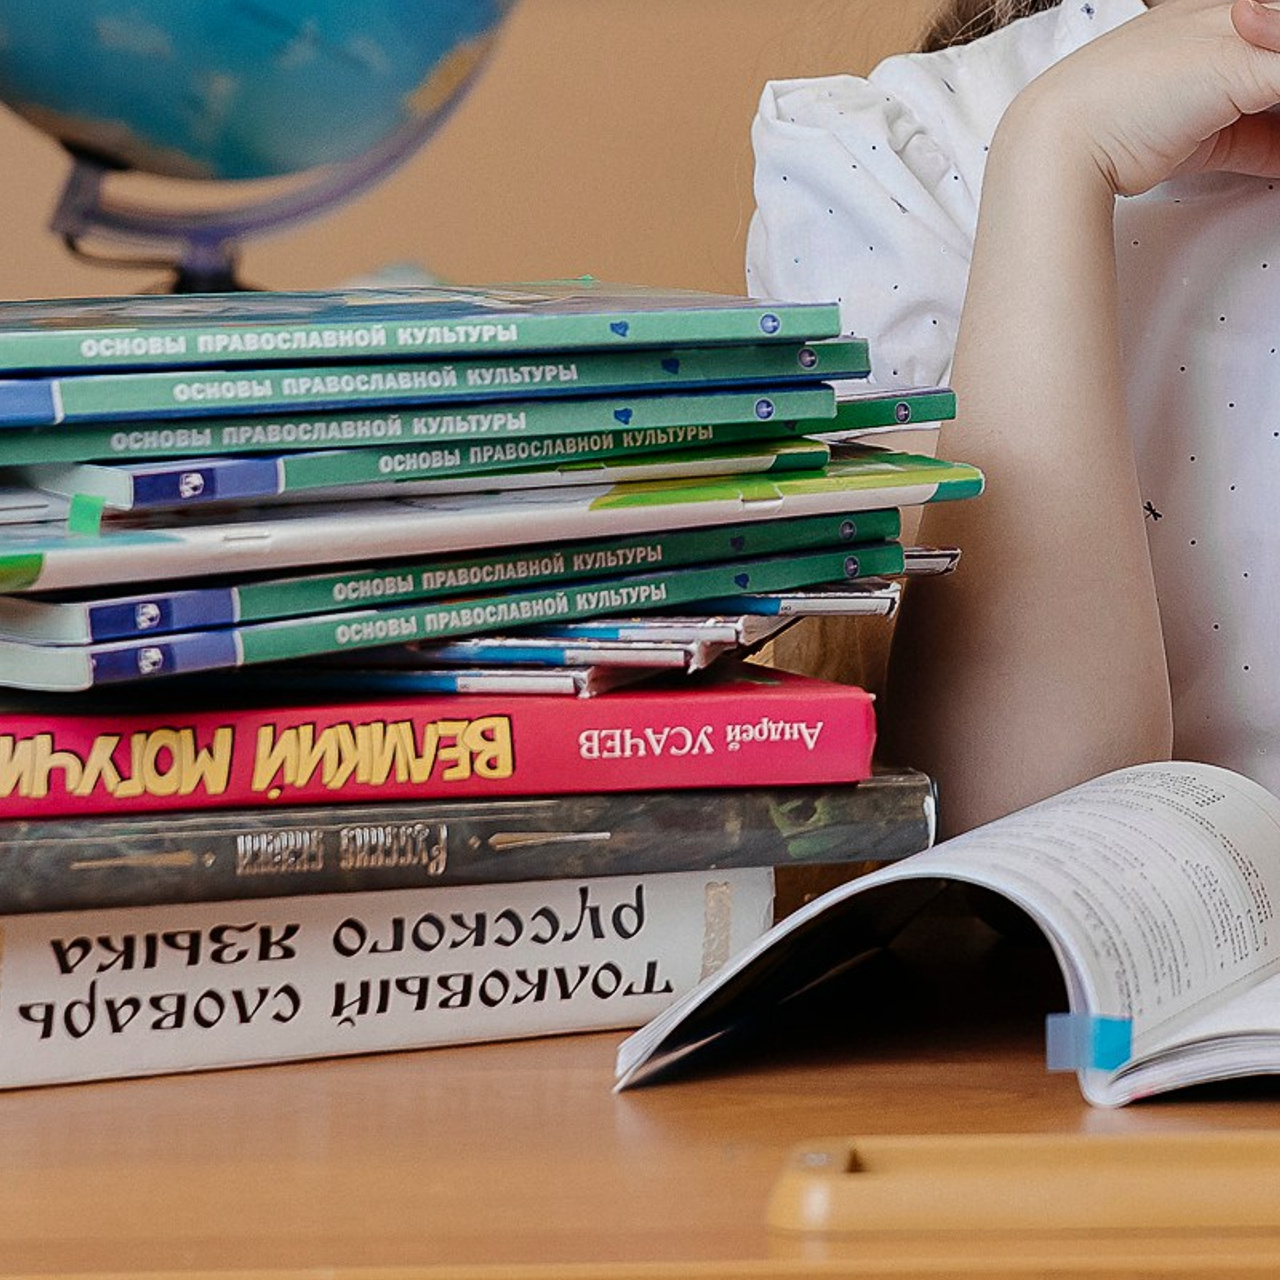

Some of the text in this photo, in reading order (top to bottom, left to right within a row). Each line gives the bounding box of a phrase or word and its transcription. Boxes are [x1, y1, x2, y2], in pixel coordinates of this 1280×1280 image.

[80, 322, 518, 358] ОСНОВЫ ПРАВОСЛАВНОЙ КУЛЬТУРЫ
[173, 364, 578, 402] ОСНОВЫ ПРАВОСЛАВНОЙ КУЛЬТУРЫ
[110, 412, 526, 451] ОСНОВЫ ПРАВОСЛАВНОЙ КУЛЬТУРЫ
[379, 424, 713, 473] ОСНОВЫ ПРАВОСЛАВНОЙ КУЛЬТУРЫ
[333, 545, 662, 601] ОСНОВЫ ПРАВОСЛАВНОЙ КУЛЬТУРЫ
[336, 583, 666, 643] ОСНОВЫ ПРАВОСЛАВНОЙ КУЛЬТУРЫ
[251, 715, 514, 801] ВЕЛИКИЙ
[578, 717, 823, 759] Андрей УСАЧЕВ
